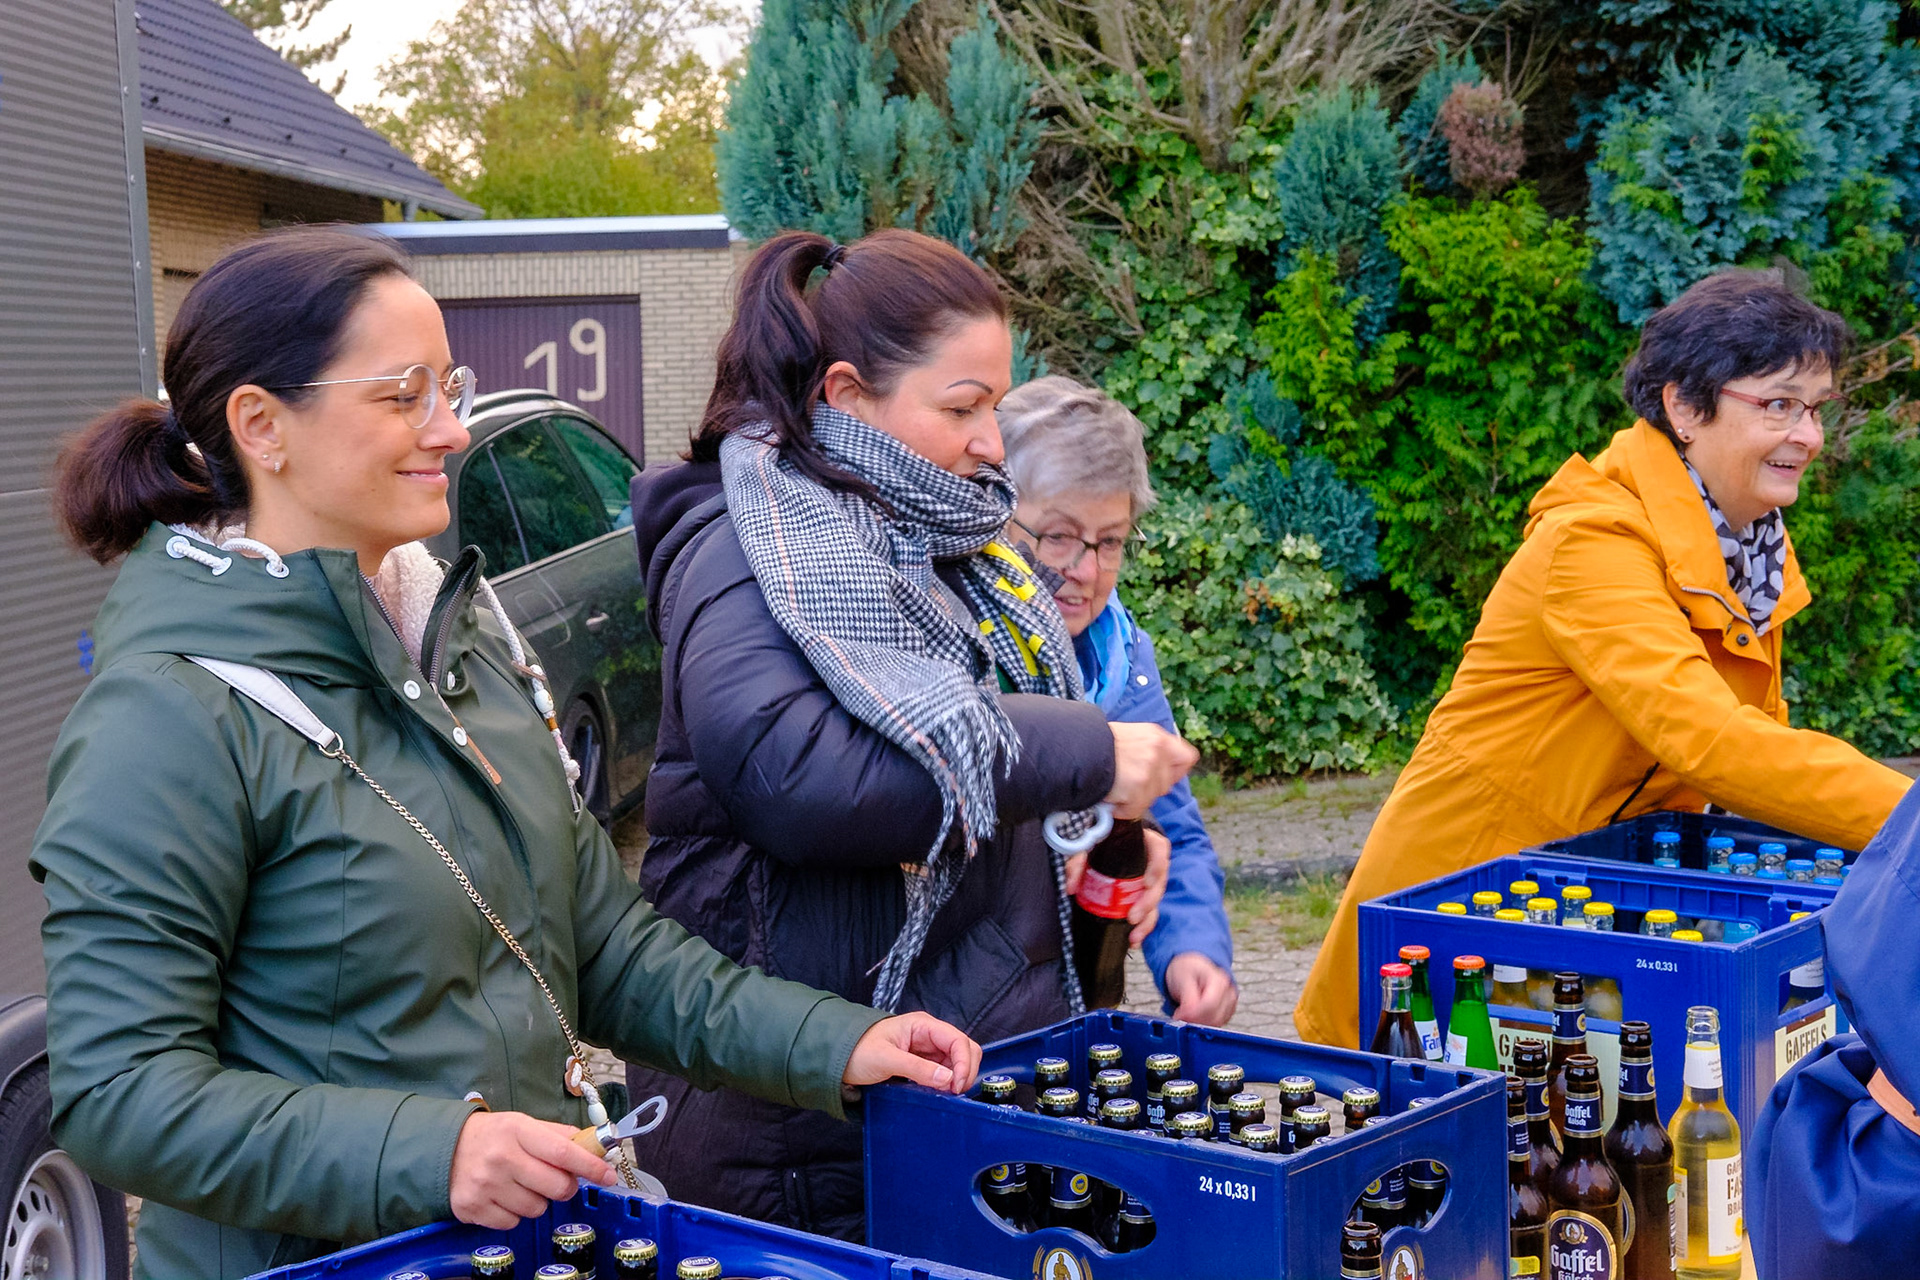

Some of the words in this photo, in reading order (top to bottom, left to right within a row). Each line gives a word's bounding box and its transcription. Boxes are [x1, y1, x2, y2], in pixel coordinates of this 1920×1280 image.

[524, 317, 607, 402] 19
[1636, 958, 1647, 969] 24
[1648, 961, 1655, 970] x
[1199, 1176, 1213, 1193] 24
[1215, 1182, 1222, 1195] x
[1224, 1180, 1249, 1200] 0,33
[1550, 1244, 1605, 1274] Gaffel
